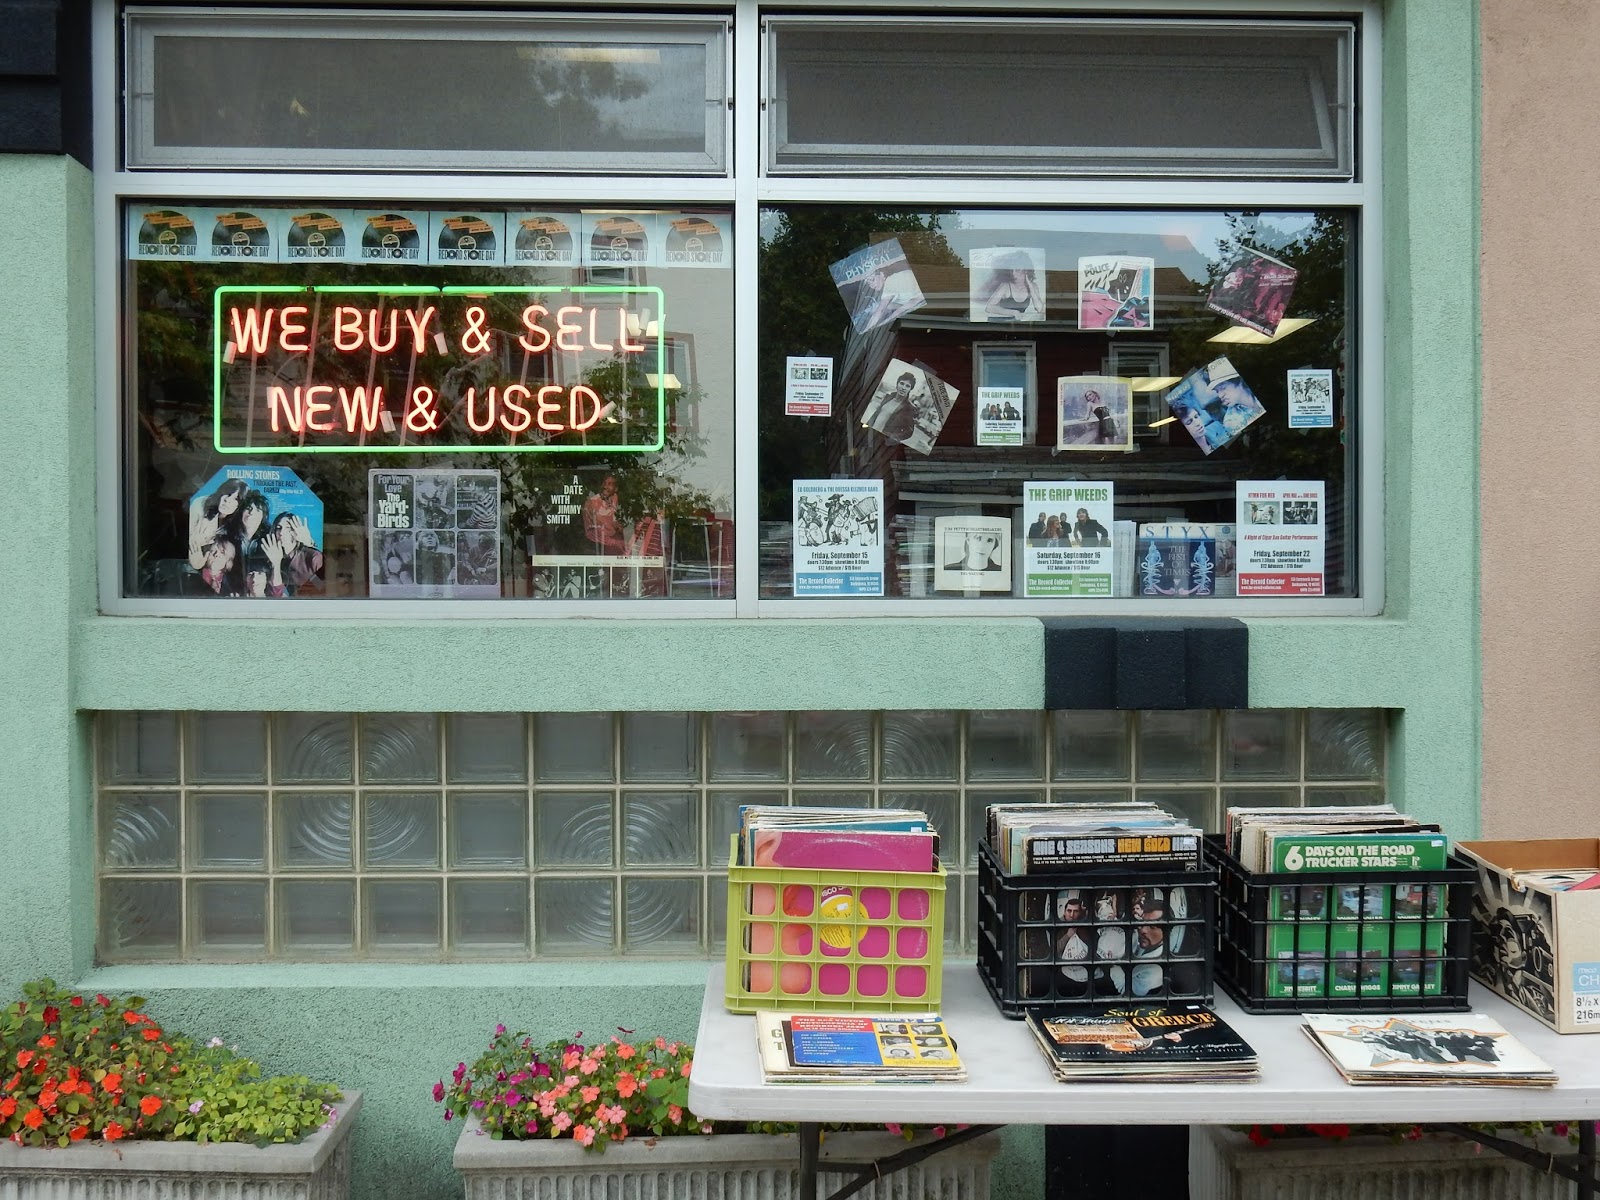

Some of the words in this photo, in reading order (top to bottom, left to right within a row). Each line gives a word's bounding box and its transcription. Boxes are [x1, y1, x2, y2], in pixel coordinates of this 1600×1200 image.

[844, 253, 891, 281] PHYSICAL
[1084, 262, 1110, 278] POLICE
[228, 305, 310, 355] WE
[333, 305, 436, 354] BUY
[460, 305, 492, 354] &
[518, 304, 646, 353] SELL
[270, 384, 383, 433] NEW
[406, 385, 438, 432] &
[466, 384, 602, 432] USED
[226, 469, 254, 480] ROLLING
[255, 470, 280, 480] STONES
[378, 474, 391, 484] For
[391, 474, 409, 485] Your
[573, 475, 579, 485] A
[384, 484, 402, 493] Love
[563, 485, 583, 495] DATE
[386, 493, 401, 502] The
[551, 494, 571, 504] WITH
[1028, 488, 1047, 501] THE
[1048, 488, 1073, 501] GRIP
[1074, 488, 1108, 501] WEEDS
[378, 499, 409, 514] Yard-
[557, 504, 581, 514] JIMMY
[377, 513, 410, 528] Birds
[546, 514, 571, 524] SMITH
[1145, 525, 1210, 539] STYX
[811, 552, 829, 560] Friday,
[830, 552, 861, 560] September
[1036, 551, 1062, 560] Saturday,
[1063, 551, 1094, 560] September
[1253, 550, 1271, 558] Friday,
[1163, 568, 1192, 576] TIMES
[1056, 840, 1065, 855] 4
[1065, 838, 1115, 854] SEASONS
[1117, 837, 1142, 853] NEW
[1305, 845, 1335, 857] DAYS
[1335, 845, 1355, 856] ON
[1356, 845, 1380, 856] THE
[1380, 844, 1415, 856] ROAD
[1284, 845, 1304, 871] 6
[1305, 857, 1359, 868] TRUCKER
[1360, 856, 1397, 867] STARS
[1103, 1008, 1146, 1017] Soul
[1148, 1008, 1167, 1017] of
[1132, 1012, 1217, 1028] GREECE
